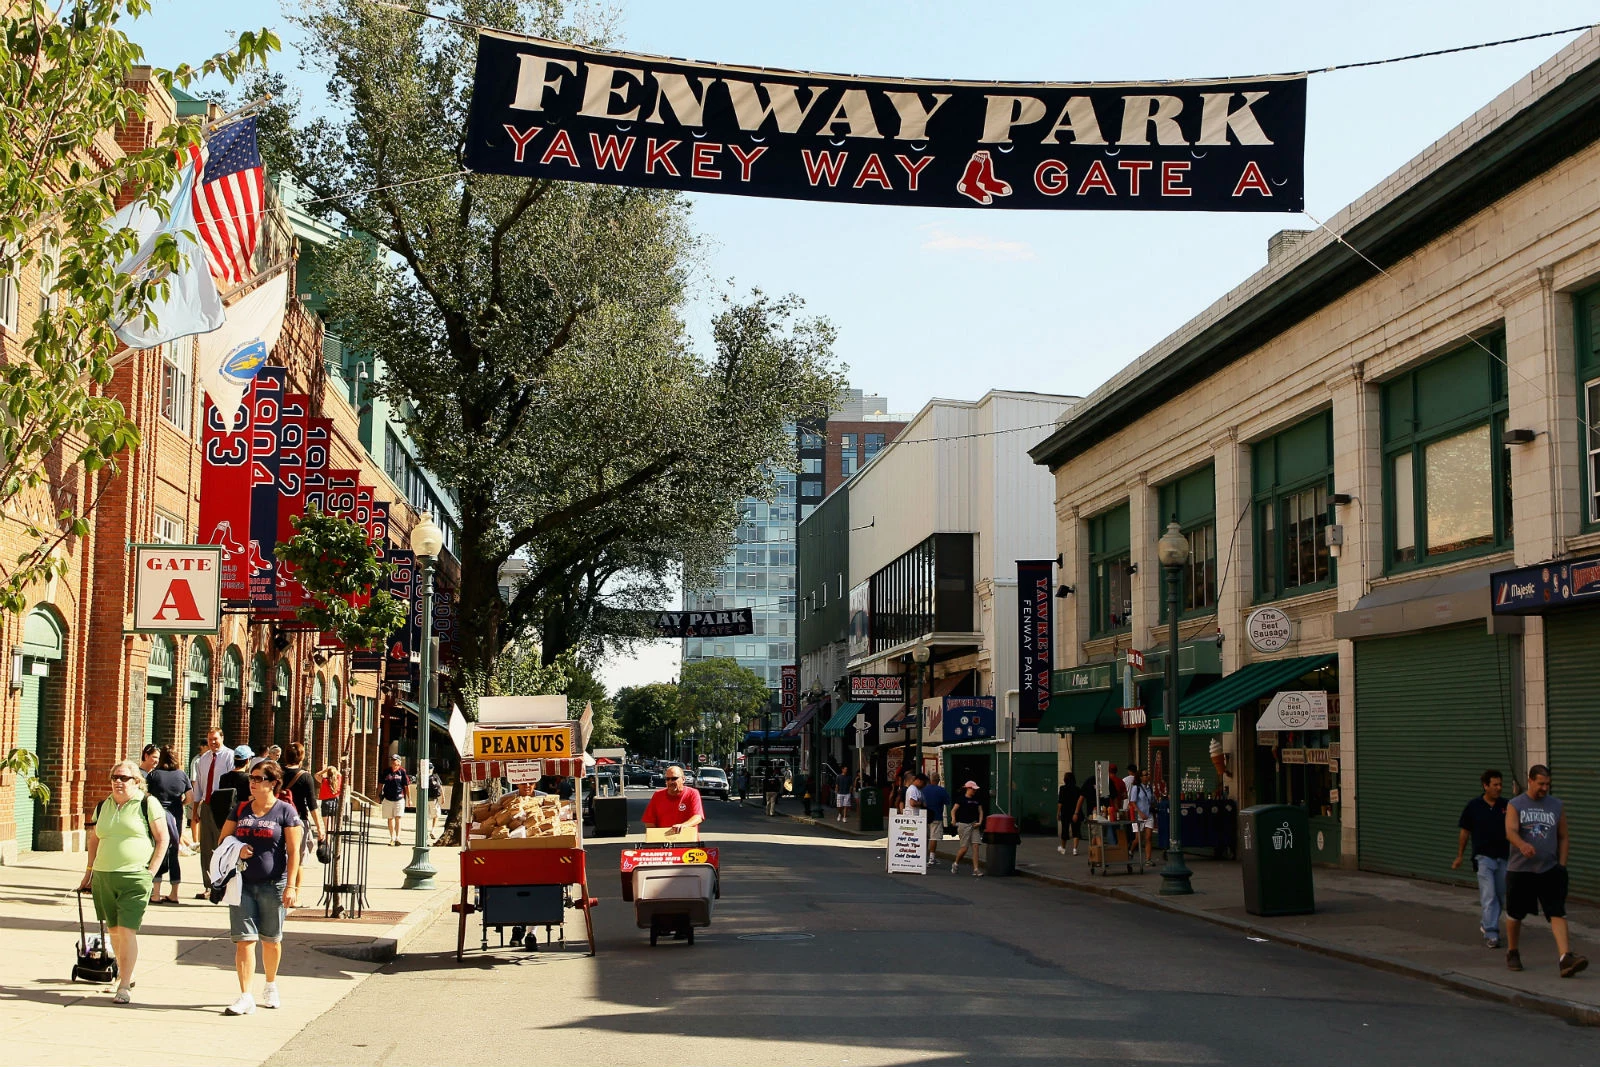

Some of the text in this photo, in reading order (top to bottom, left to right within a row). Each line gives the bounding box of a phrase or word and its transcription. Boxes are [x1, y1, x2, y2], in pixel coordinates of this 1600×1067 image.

[509, 53, 1275, 147] FENWAY PARK
[502, 123, 1273, 197] YAWKEY WAY GATE A
[278, 403, 304, 497] 1912
[146, 558, 212, 572] GATE
[152, 578, 205, 621] A
[1510, 582, 1536, 600] Majestic
[689, 611, 748, 626] PARK
[1036, 576, 1049, 665] YAWKEY
[1261, 622, 1278, 630] Best
[1253, 629, 1288, 638] Sausage
[1023, 599, 1033, 691] FENWAY PARK
[852, 677, 901, 690] RED SOX
[1178, 720, 1188, 731] EST
[481, 733, 565, 754] PEANUTS
[1520, 809, 1556, 826] PATRIOTS
